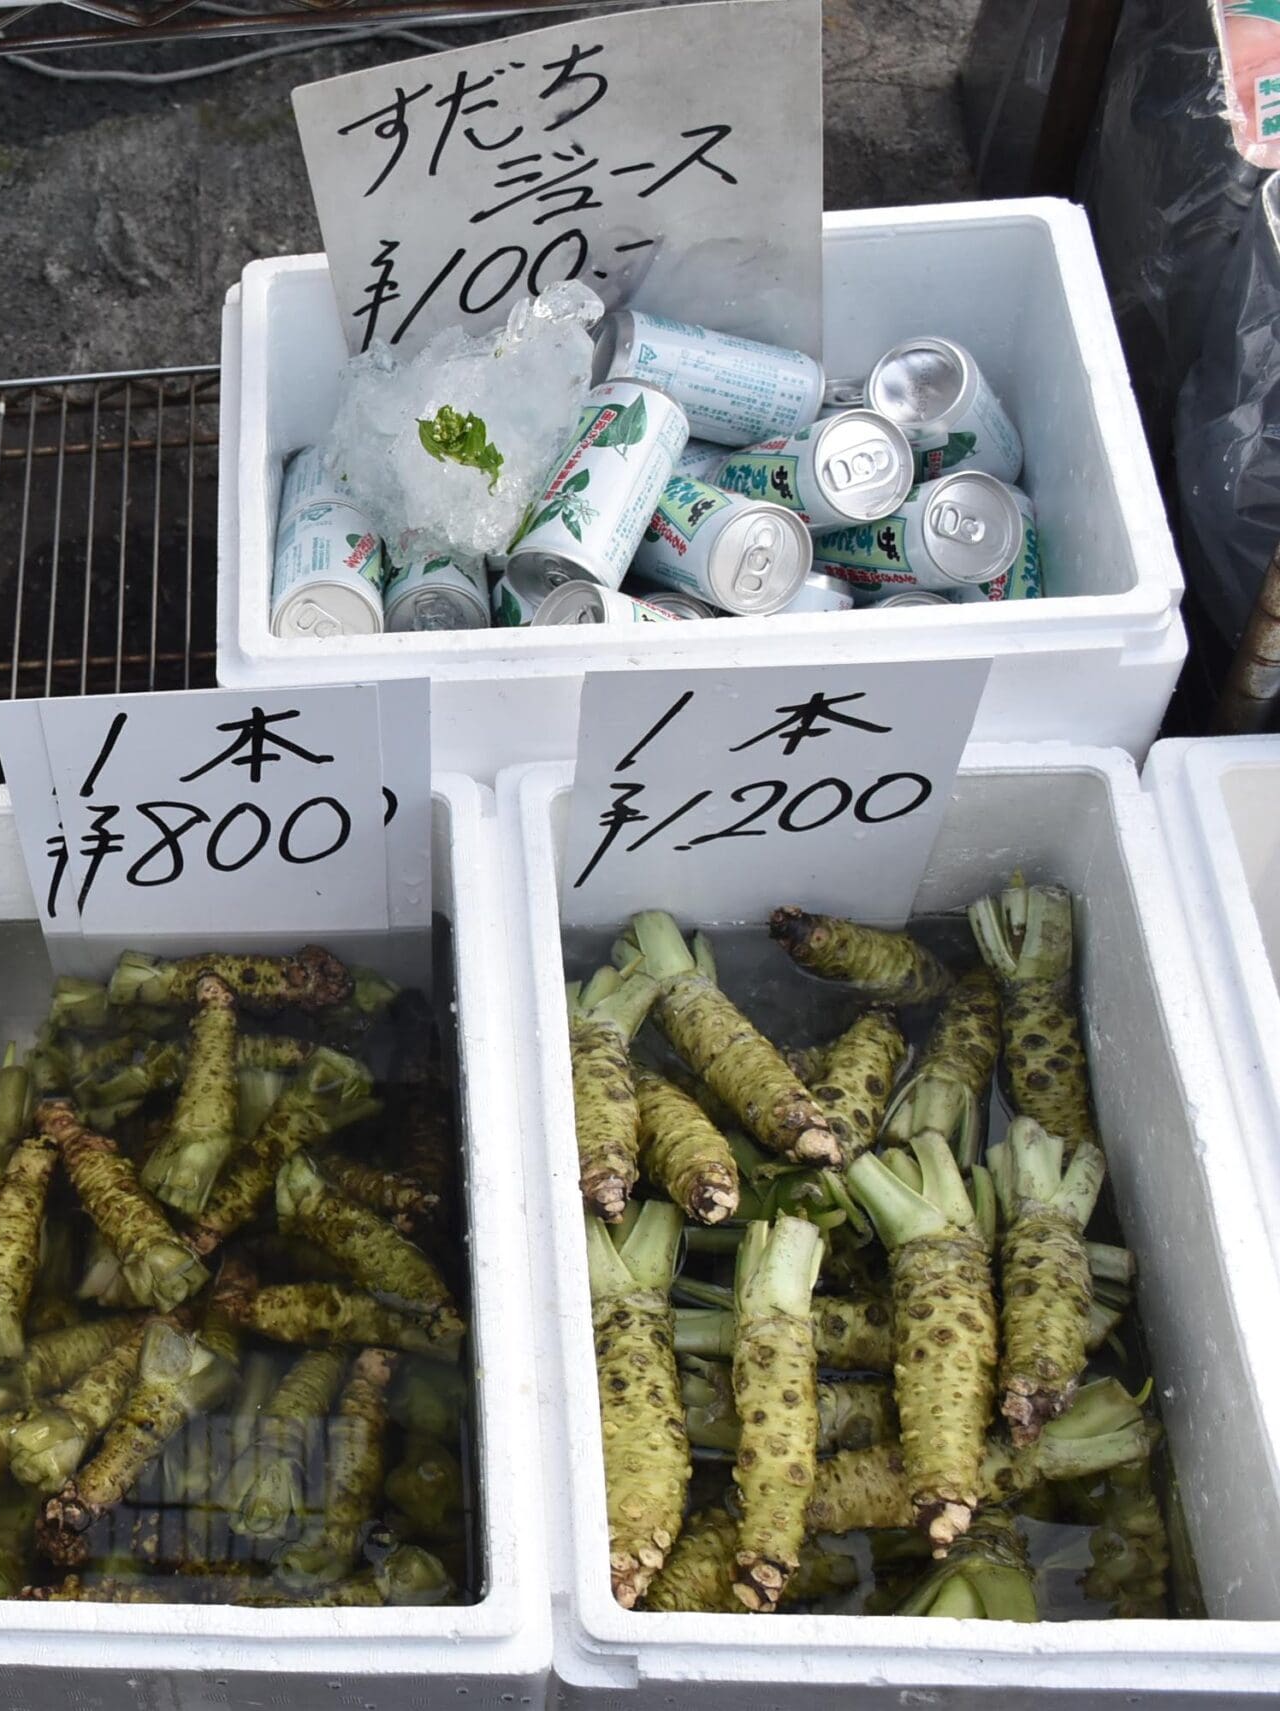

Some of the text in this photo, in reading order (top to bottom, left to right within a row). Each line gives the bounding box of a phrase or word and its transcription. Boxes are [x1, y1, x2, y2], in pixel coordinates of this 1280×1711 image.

[338, 43, 609, 198] すだち
[468, 123, 739, 225] ジュース
[77, 796, 352, 918] ¥800
